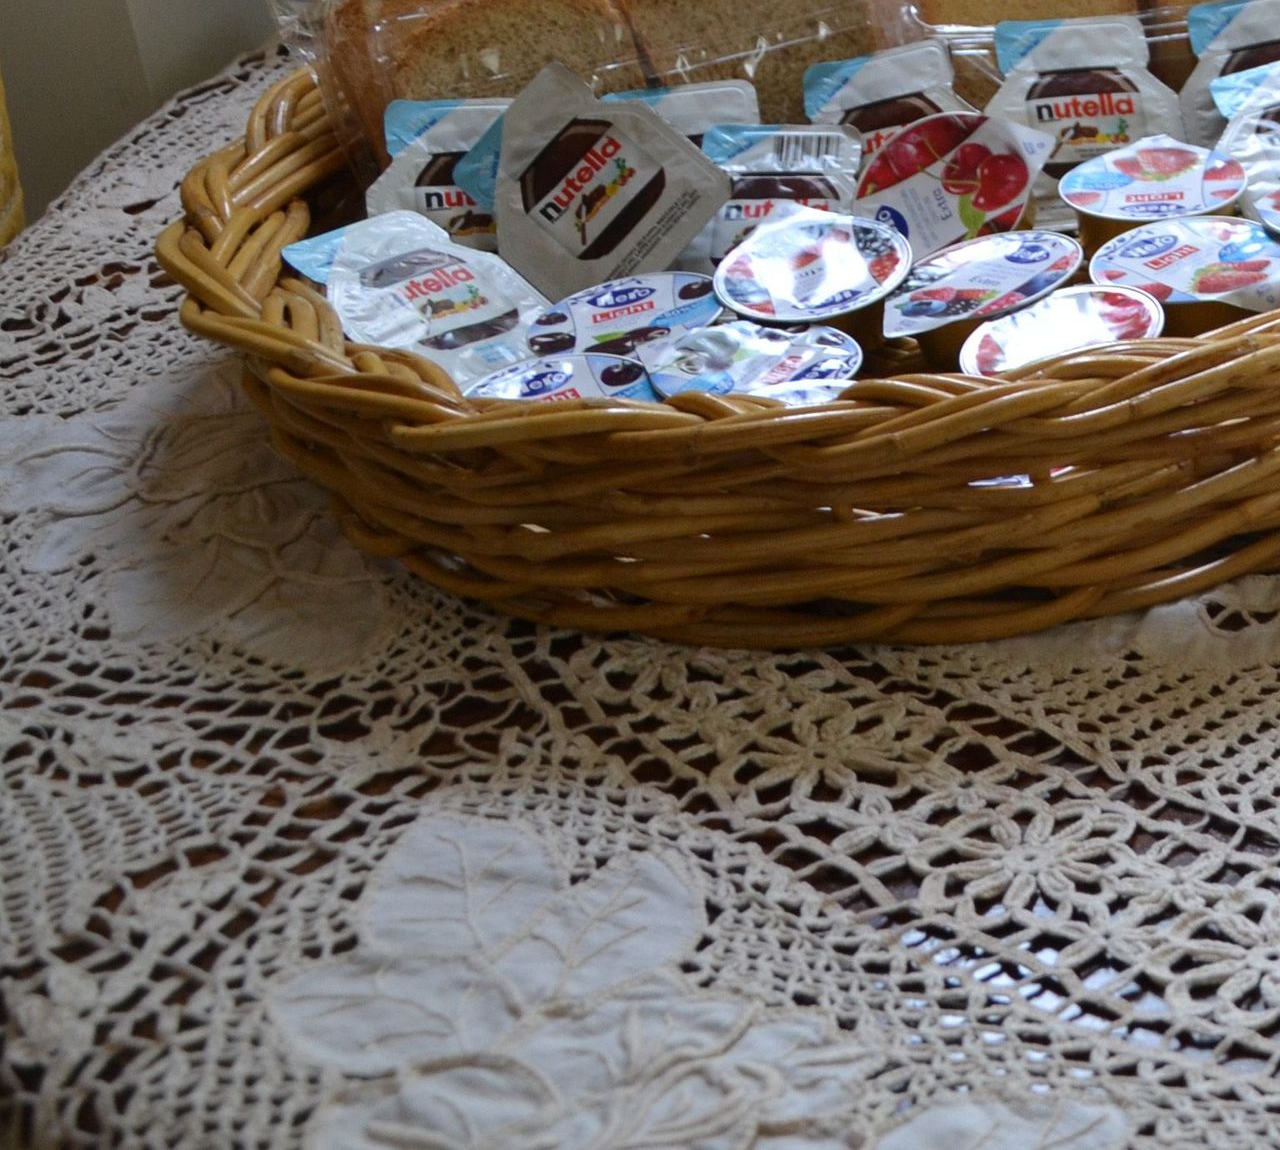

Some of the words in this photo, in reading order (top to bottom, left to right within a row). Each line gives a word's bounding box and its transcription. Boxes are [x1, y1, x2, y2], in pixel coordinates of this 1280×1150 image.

[1036, 92, 1136, 121] nutella
[539, 136, 622, 223] nutella
[1145, 245, 1196, 269] Light
